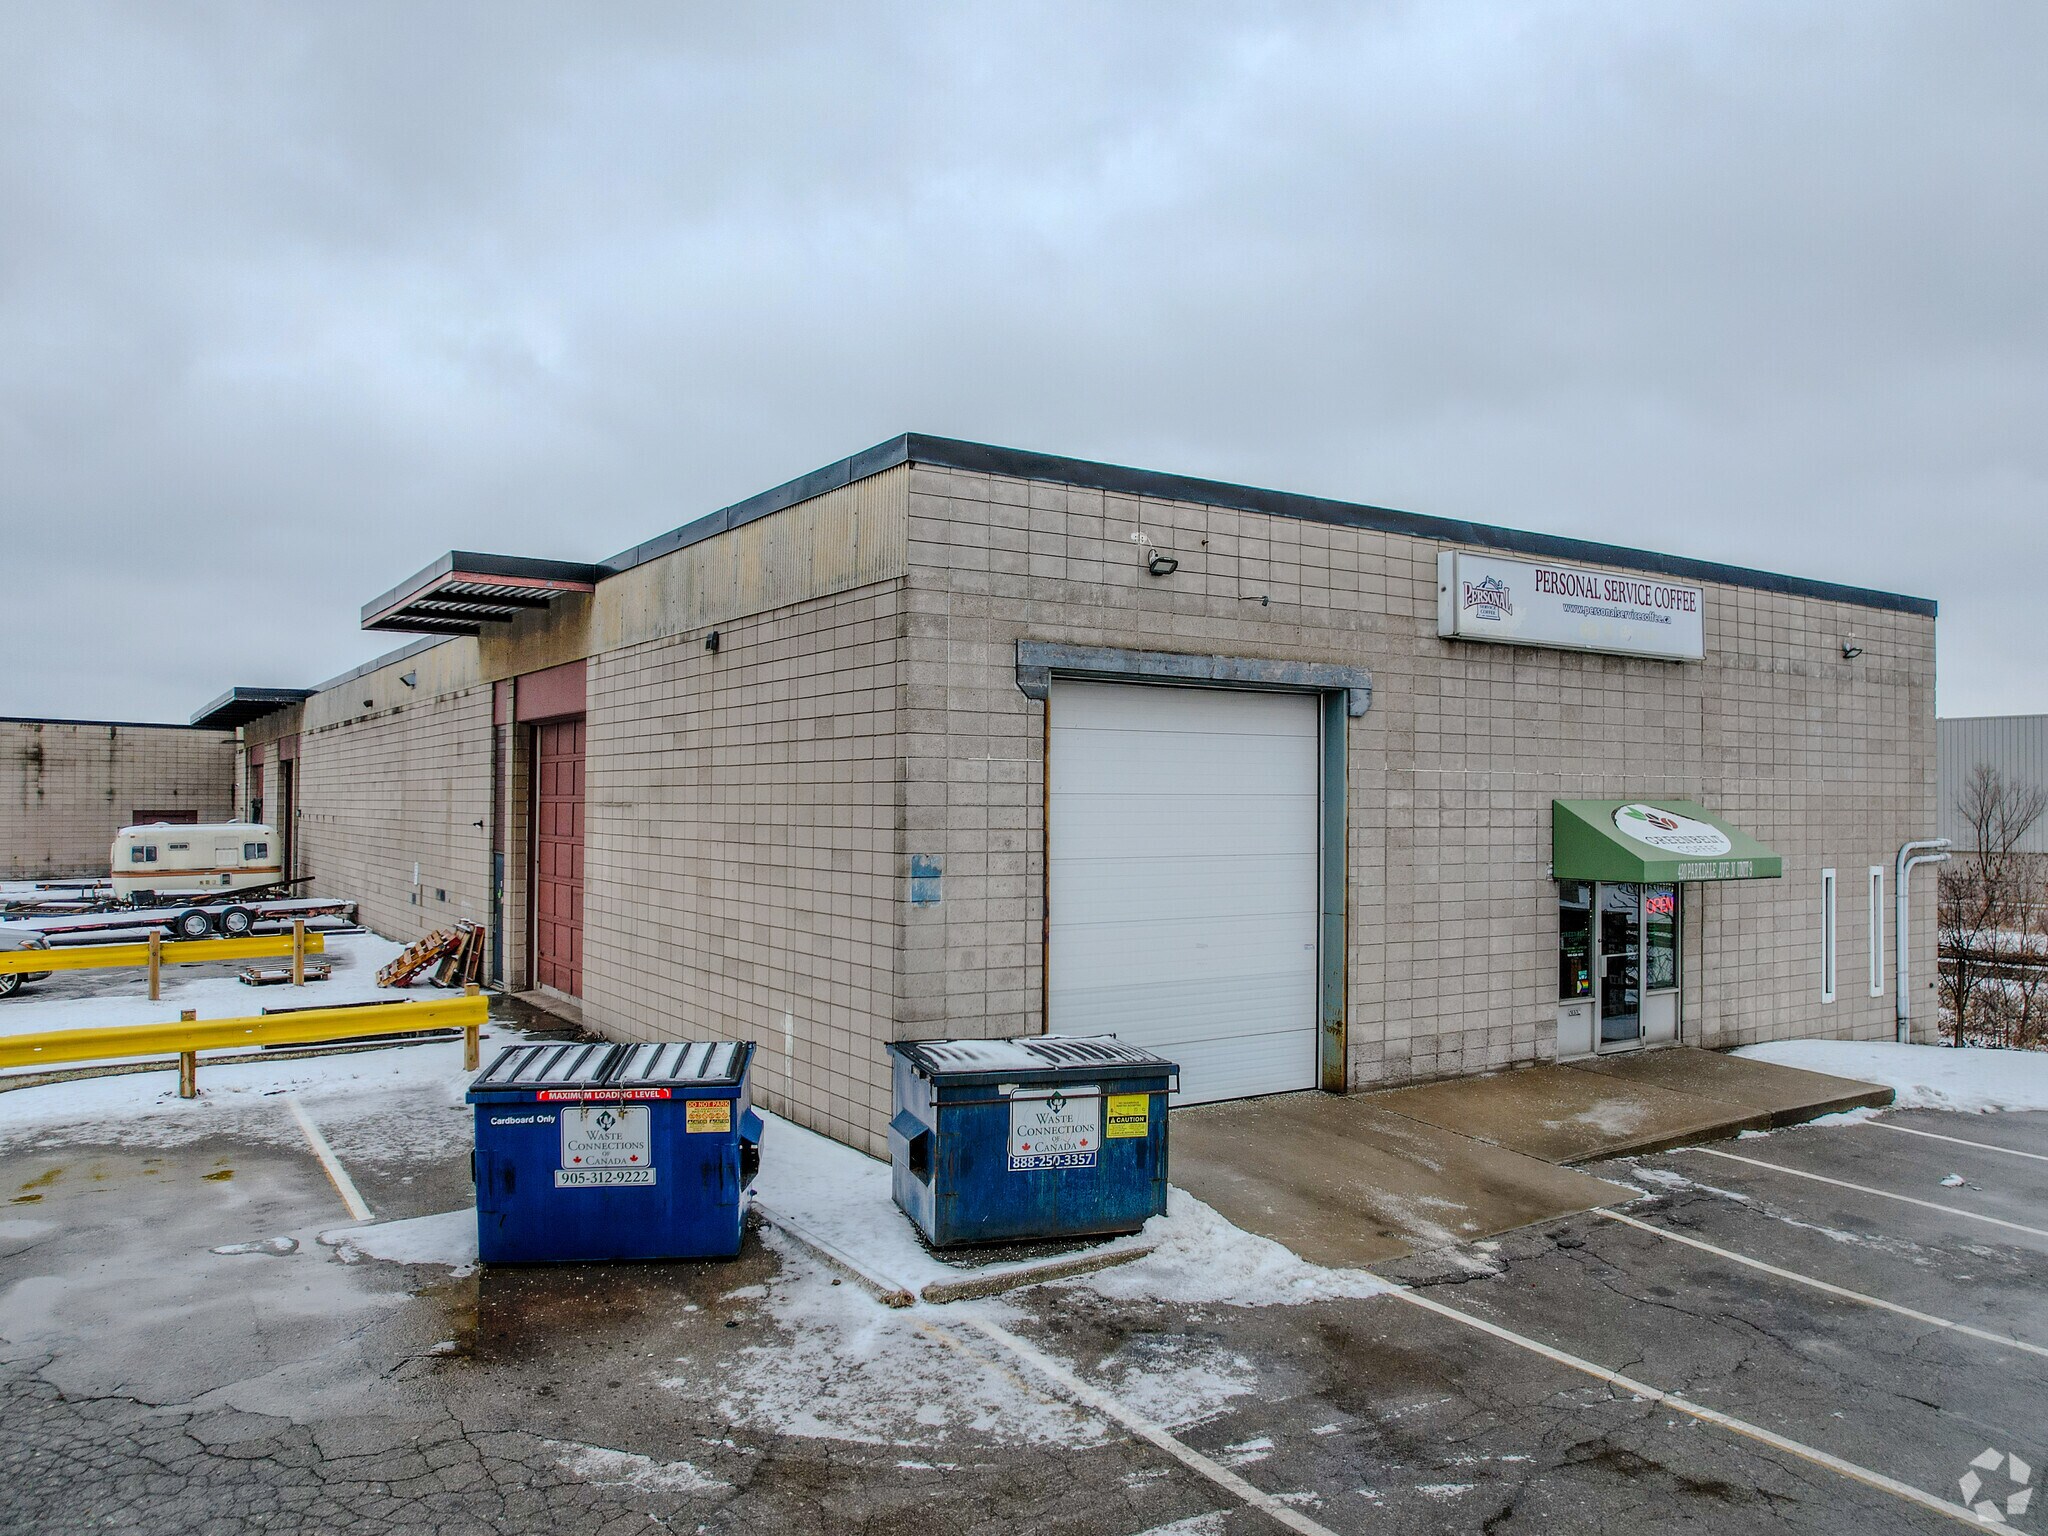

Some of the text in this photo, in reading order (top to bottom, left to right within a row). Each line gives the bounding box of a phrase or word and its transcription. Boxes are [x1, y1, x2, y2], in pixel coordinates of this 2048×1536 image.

[1535, 569, 1697, 612] PERSONAL SERVICE COFFEE
[1463, 581, 1512, 616] PERSONAL
[1562, 602, 1672, 624] www.personalservicecoffee.ca
[1645, 835, 1724, 844] GREENBELT
[1688, 862, 1716, 879] PARKDALE
[1737, 861, 1748, 877] UNIT
[1646, 896, 1674, 914] OPEN
[548, 1090, 660, 1100] MAXIMUM LOADING LEVEL
[490, 1115, 556, 1125] Cardboard Only
[1036, 1112, 1073, 1124] WASTE
[586, 1130, 623, 1140] WASTE
[1017, 1124, 1095, 1137] CONNECTIONS
[567, 1140, 644, 1151] CONNECTIONS
[1034, 1141, 1077, 1153] CANADA
[585, 1155, 627, 1166] CANADA
[1012, 1153, 1093, 1168] 888-250-3357
[561, 1171, 649, 1185] 905-312-9222
